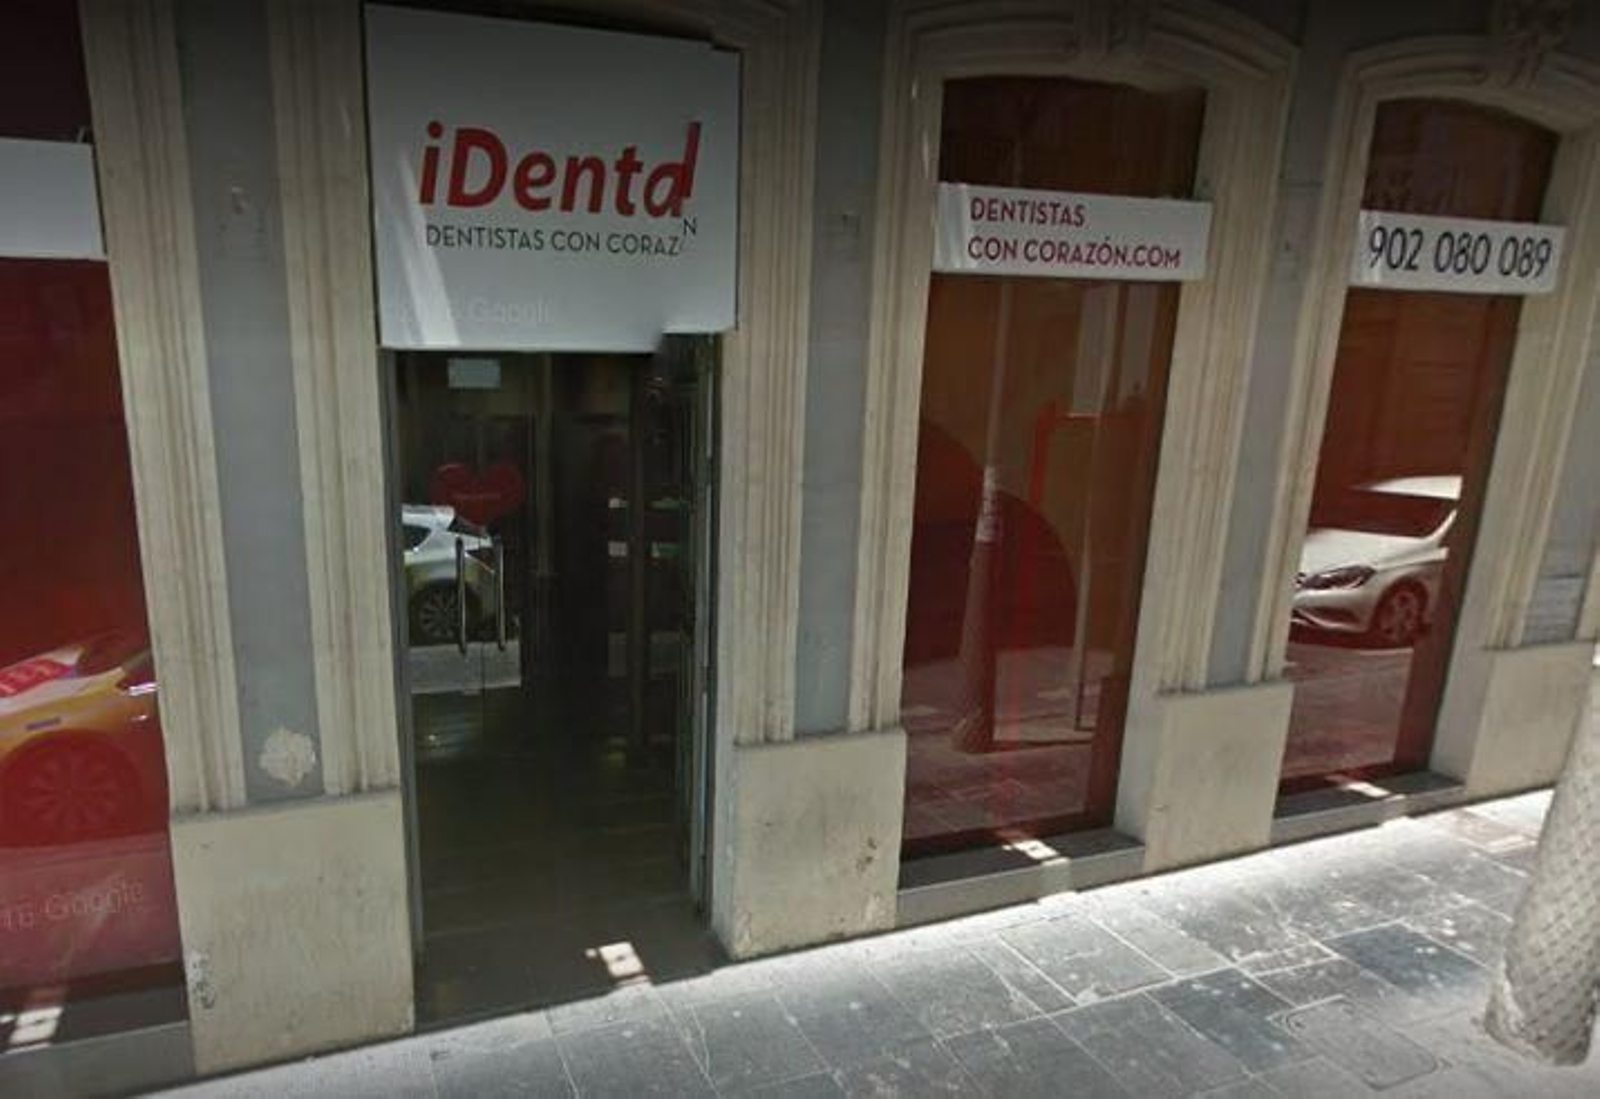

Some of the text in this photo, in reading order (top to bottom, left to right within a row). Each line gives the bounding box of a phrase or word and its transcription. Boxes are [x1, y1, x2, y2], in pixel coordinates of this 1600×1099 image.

[970, 197, 1085, 227] DENTISTAS
[426, 218, 697, 256] DENTISTAS CON CORAZN
[968, 236, 1181, 269] CON CORAZÓN.COM
[1369, 226, 1552, 278] 902 080 089
